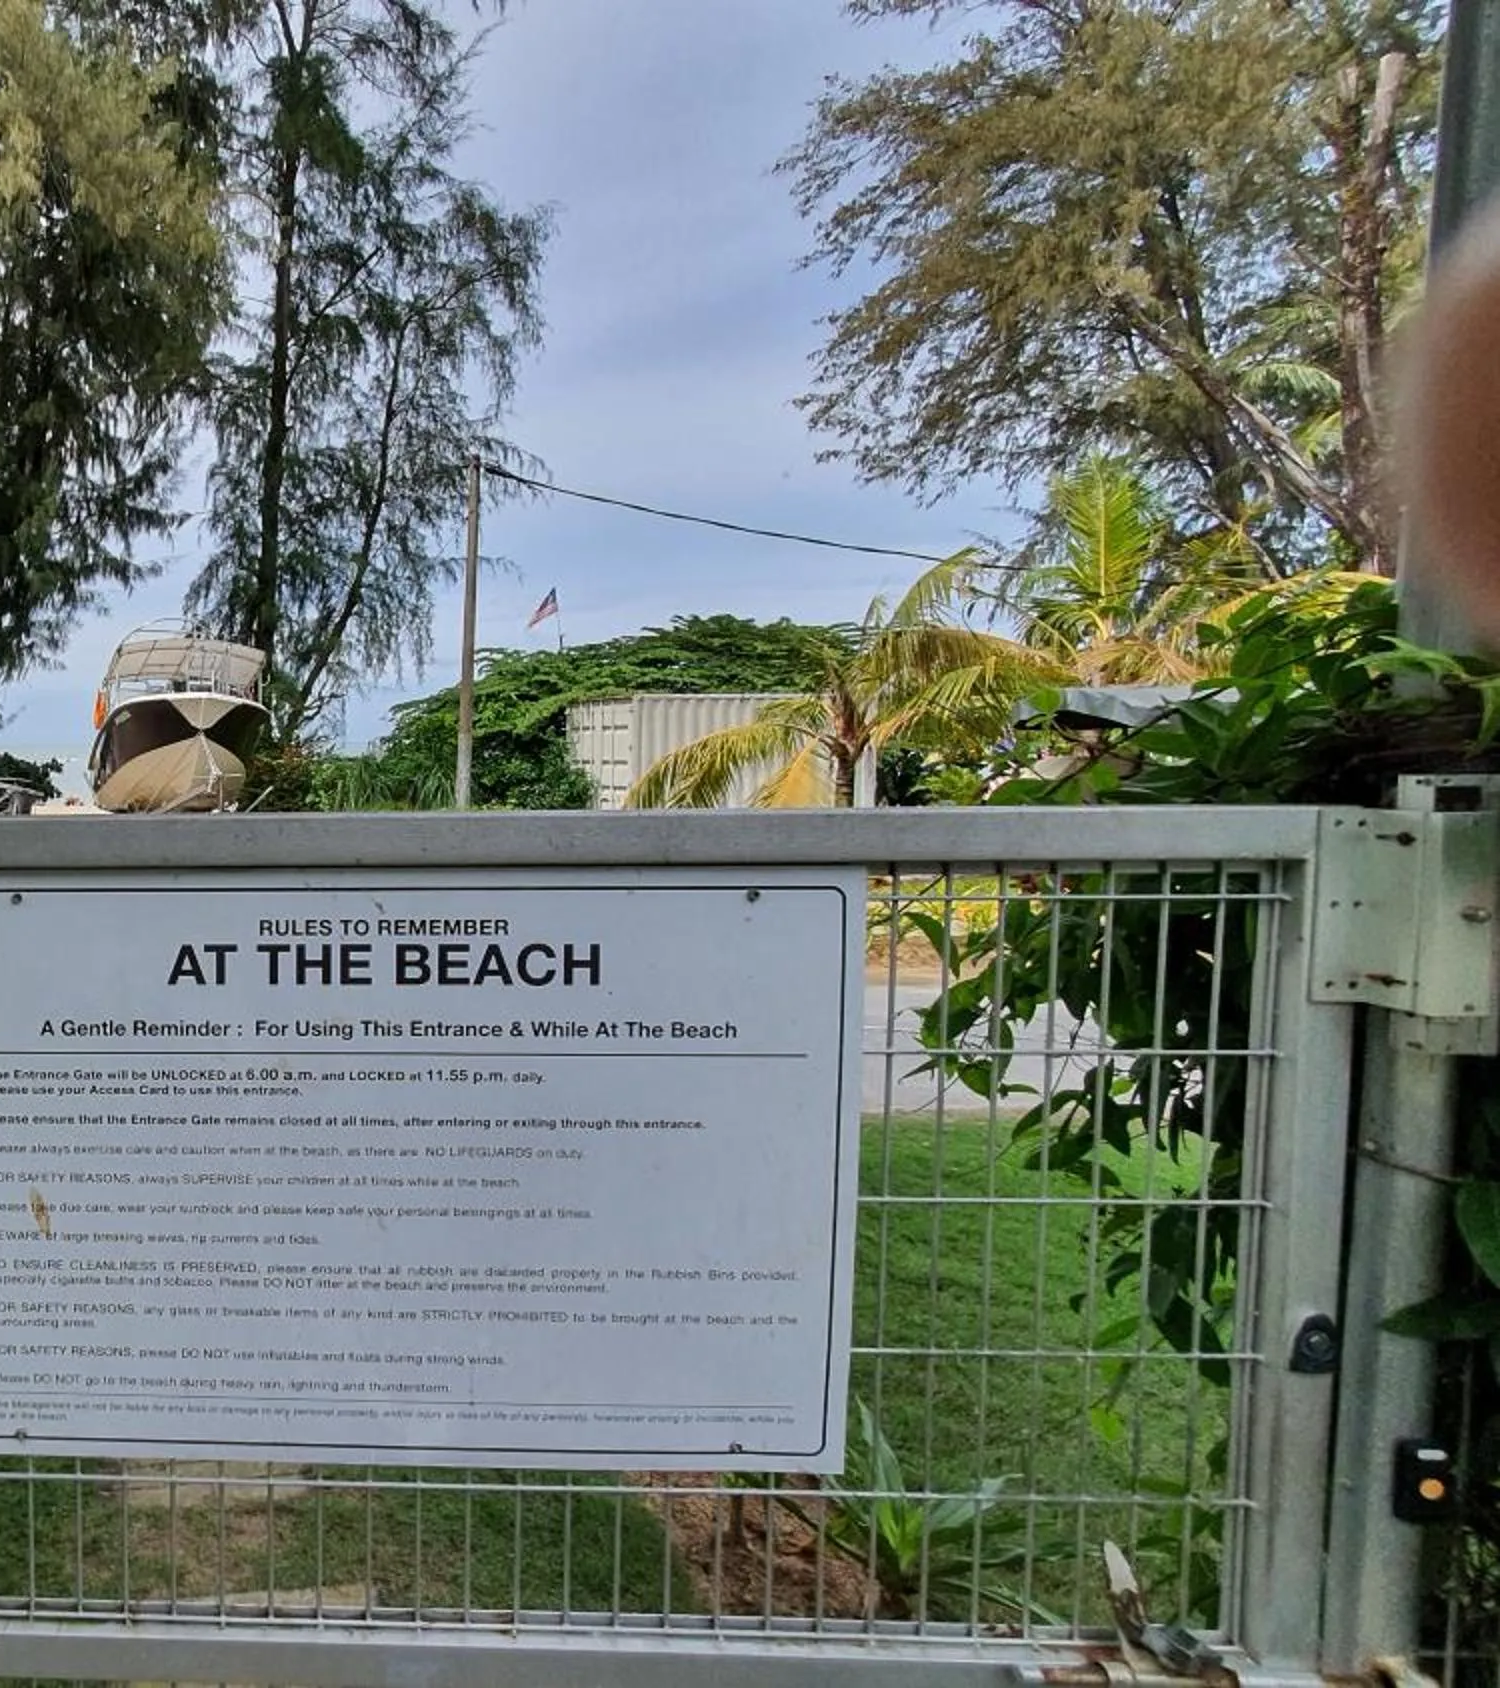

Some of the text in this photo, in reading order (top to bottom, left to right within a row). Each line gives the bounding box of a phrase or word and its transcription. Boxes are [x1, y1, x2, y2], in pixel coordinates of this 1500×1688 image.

[259, 919, 508, 936] RULES TO REMEMBER
[168, 943, 600, 986] AT THE BEACH
[40, 1019, 736, 1040] A Gentle Reminder : For Using This Entrance & While At The Beach
[13, 1069, 70, 1080] Entrance
[73, 1069, 102, 1080] Gate
[107, 1069, 128, 1079] will
[131, 1070, 147, 1080] be
[151, 1069, 226, 1080] UNLOCKED
[229, 1071, 242, 1080] at
[245, 1067, 279, 1080] 6.00
[283, 1071, 316, 1080] a.m.
[321, 1071, 344, 1080] and
[348, 1071, 405, 1080] LOCKED
[409, 1071, 421, 1081] at
[426, 1069, 468, 1081] 11.55
[472, 1071, 506, 1084] p.m.
[512, 1071, 546, 1084] daily.
[31, 1086, 54, 1094] use
[57, 1086, 85, 1096] your
[88, 1085, 135, 1094] Access
[138, 1084, 169, 1094] Card
[172, 1085, 186, 1095] to
[215, 1085, 239, 1095] this
[242, 1086, 302, 1095] entrance.
[31, 1115, 74, 1124] ensure
[78, 1114, 103, 1124] that
[106, 1114, 126, 1124] the
[130, 1114, 187, 1124] Entrance
[190, 1114, 220, 1124] Gate
[224, 1116, 274, 1125] remains
[279, 1115, 321, 1126] closed
[325, 1116, 337, 1126] at
[341, 1115, 356, 1126] all
[360, 1116, 398, 1127] times,
[403, 1117, 433, 1126] after
[437, 1117, 490, 1129] entering
[495, 1119, 508, 1127] or
[512, 1119, 556, 1130] exiting
[560, 1119, 611, 1130] through
[615, 1119, 639, 1128] this
[643, 1119, 706, 1128] entrance.
[17, 1172, 66, 1182] SAFETY
[256, 1177, 283, 1185] your
[266, 1264, 306, 1274] please
